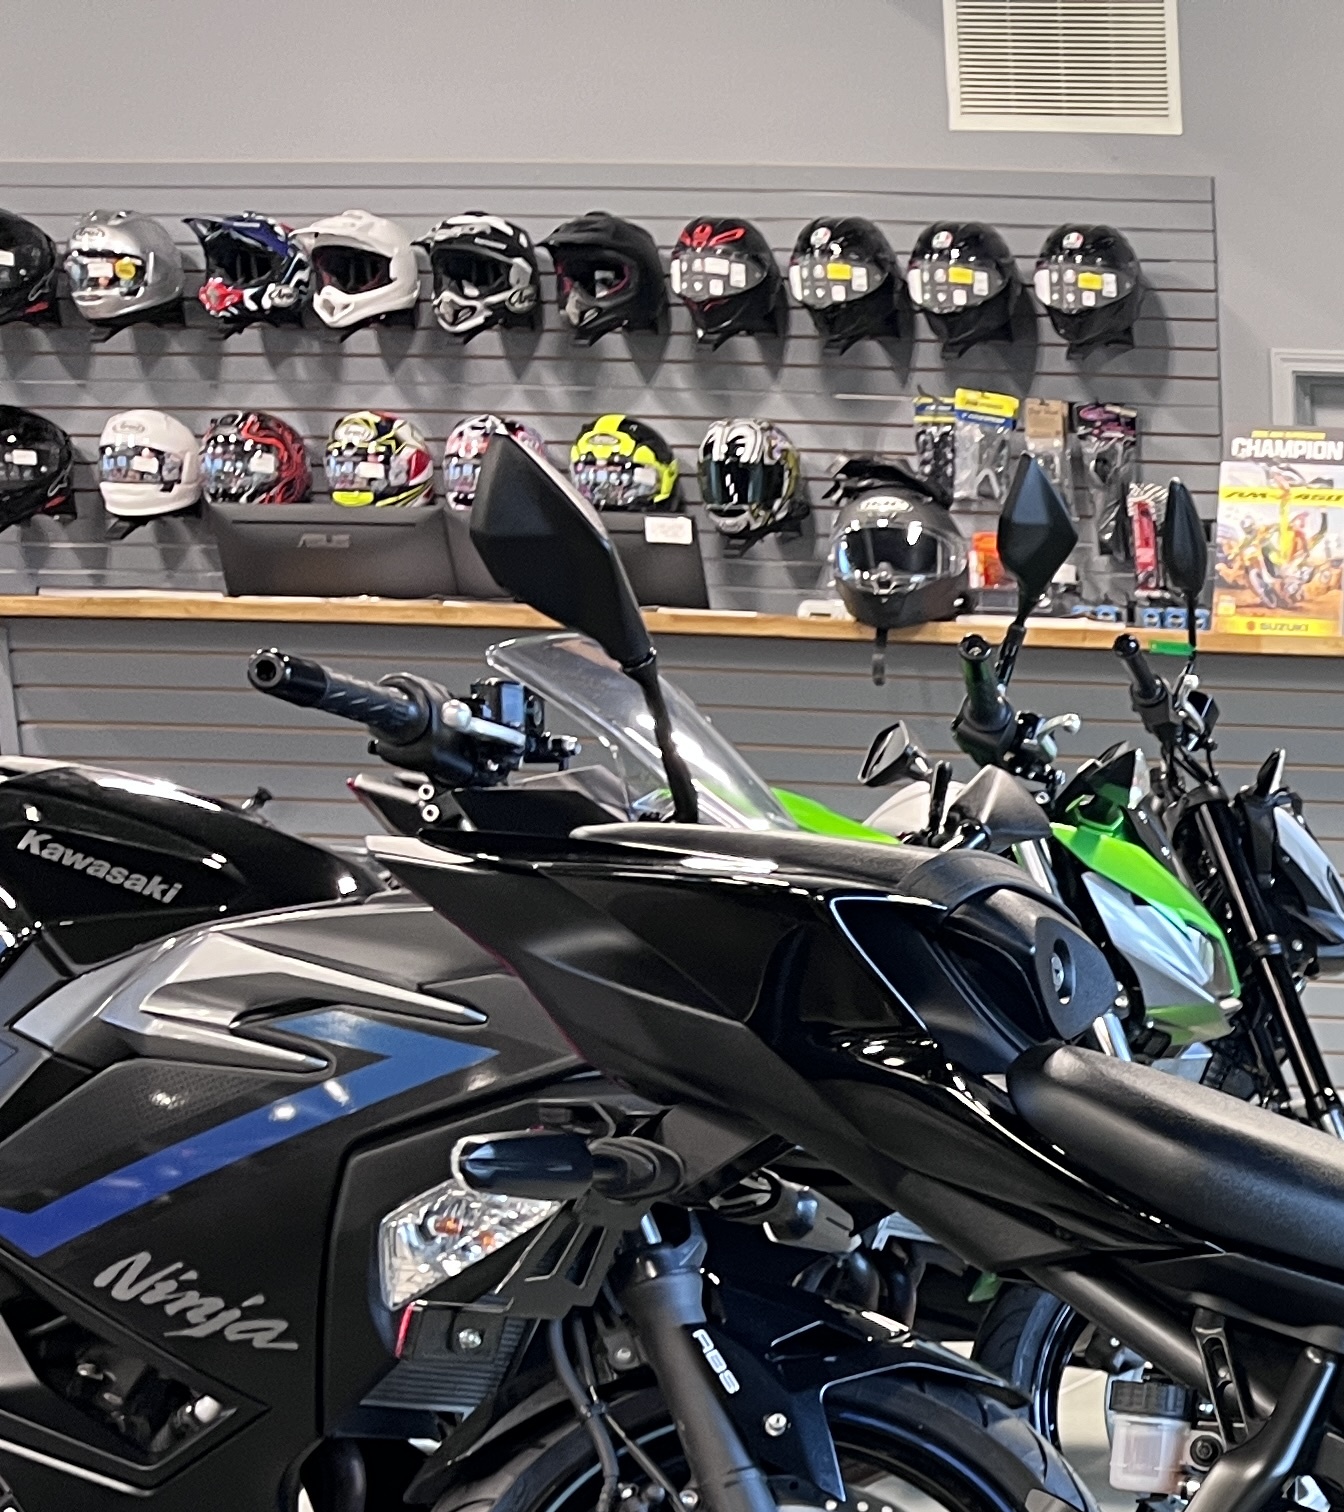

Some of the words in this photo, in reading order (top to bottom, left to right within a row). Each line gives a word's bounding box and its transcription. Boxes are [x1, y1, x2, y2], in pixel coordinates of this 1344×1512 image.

[1231, 437, 1344, 460] CHAMPION
[16, 828, 183, 905] Kawasaki
[92, 1251, 299, 1352] Ninja
[692, 1328, 740, 1395] ABS
